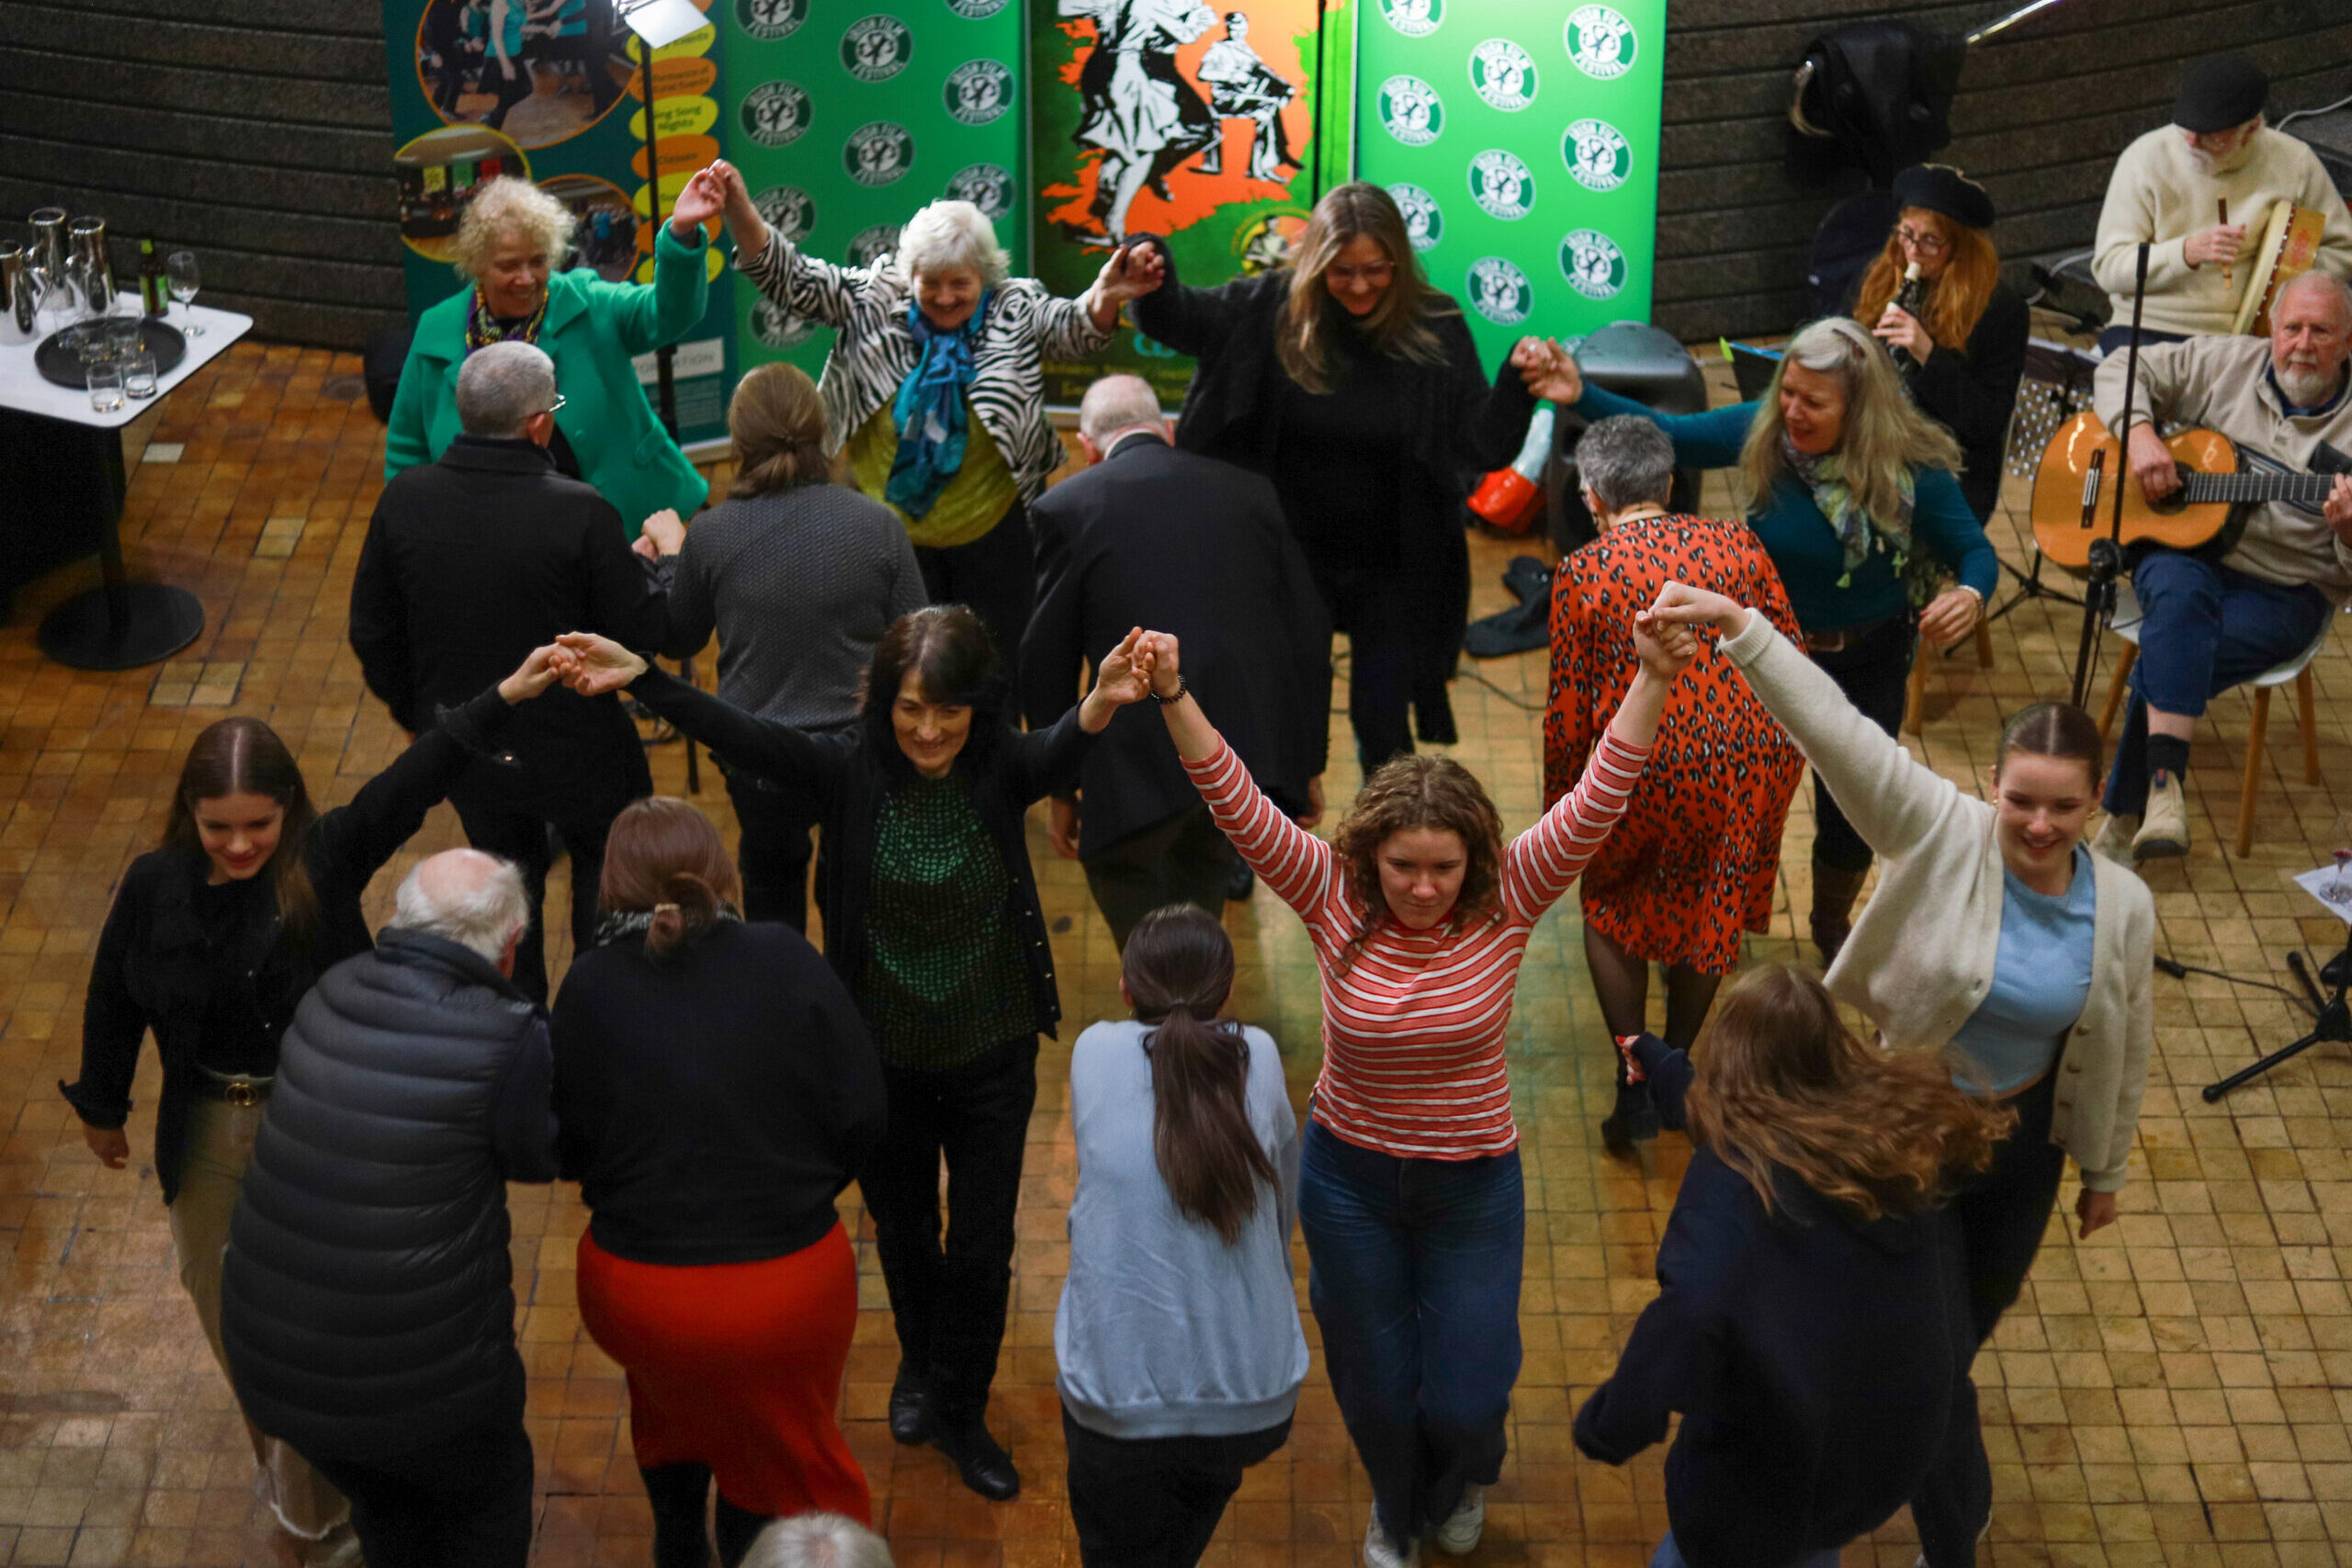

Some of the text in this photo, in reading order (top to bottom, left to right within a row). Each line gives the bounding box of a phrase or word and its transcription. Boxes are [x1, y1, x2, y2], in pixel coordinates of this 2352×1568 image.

[1573, 51, 1627, 76] FESTIVAL
[1478, 84, 1530, 109] FESTIVAL
[1570, 164, 1623, 188] FESTIVAL
